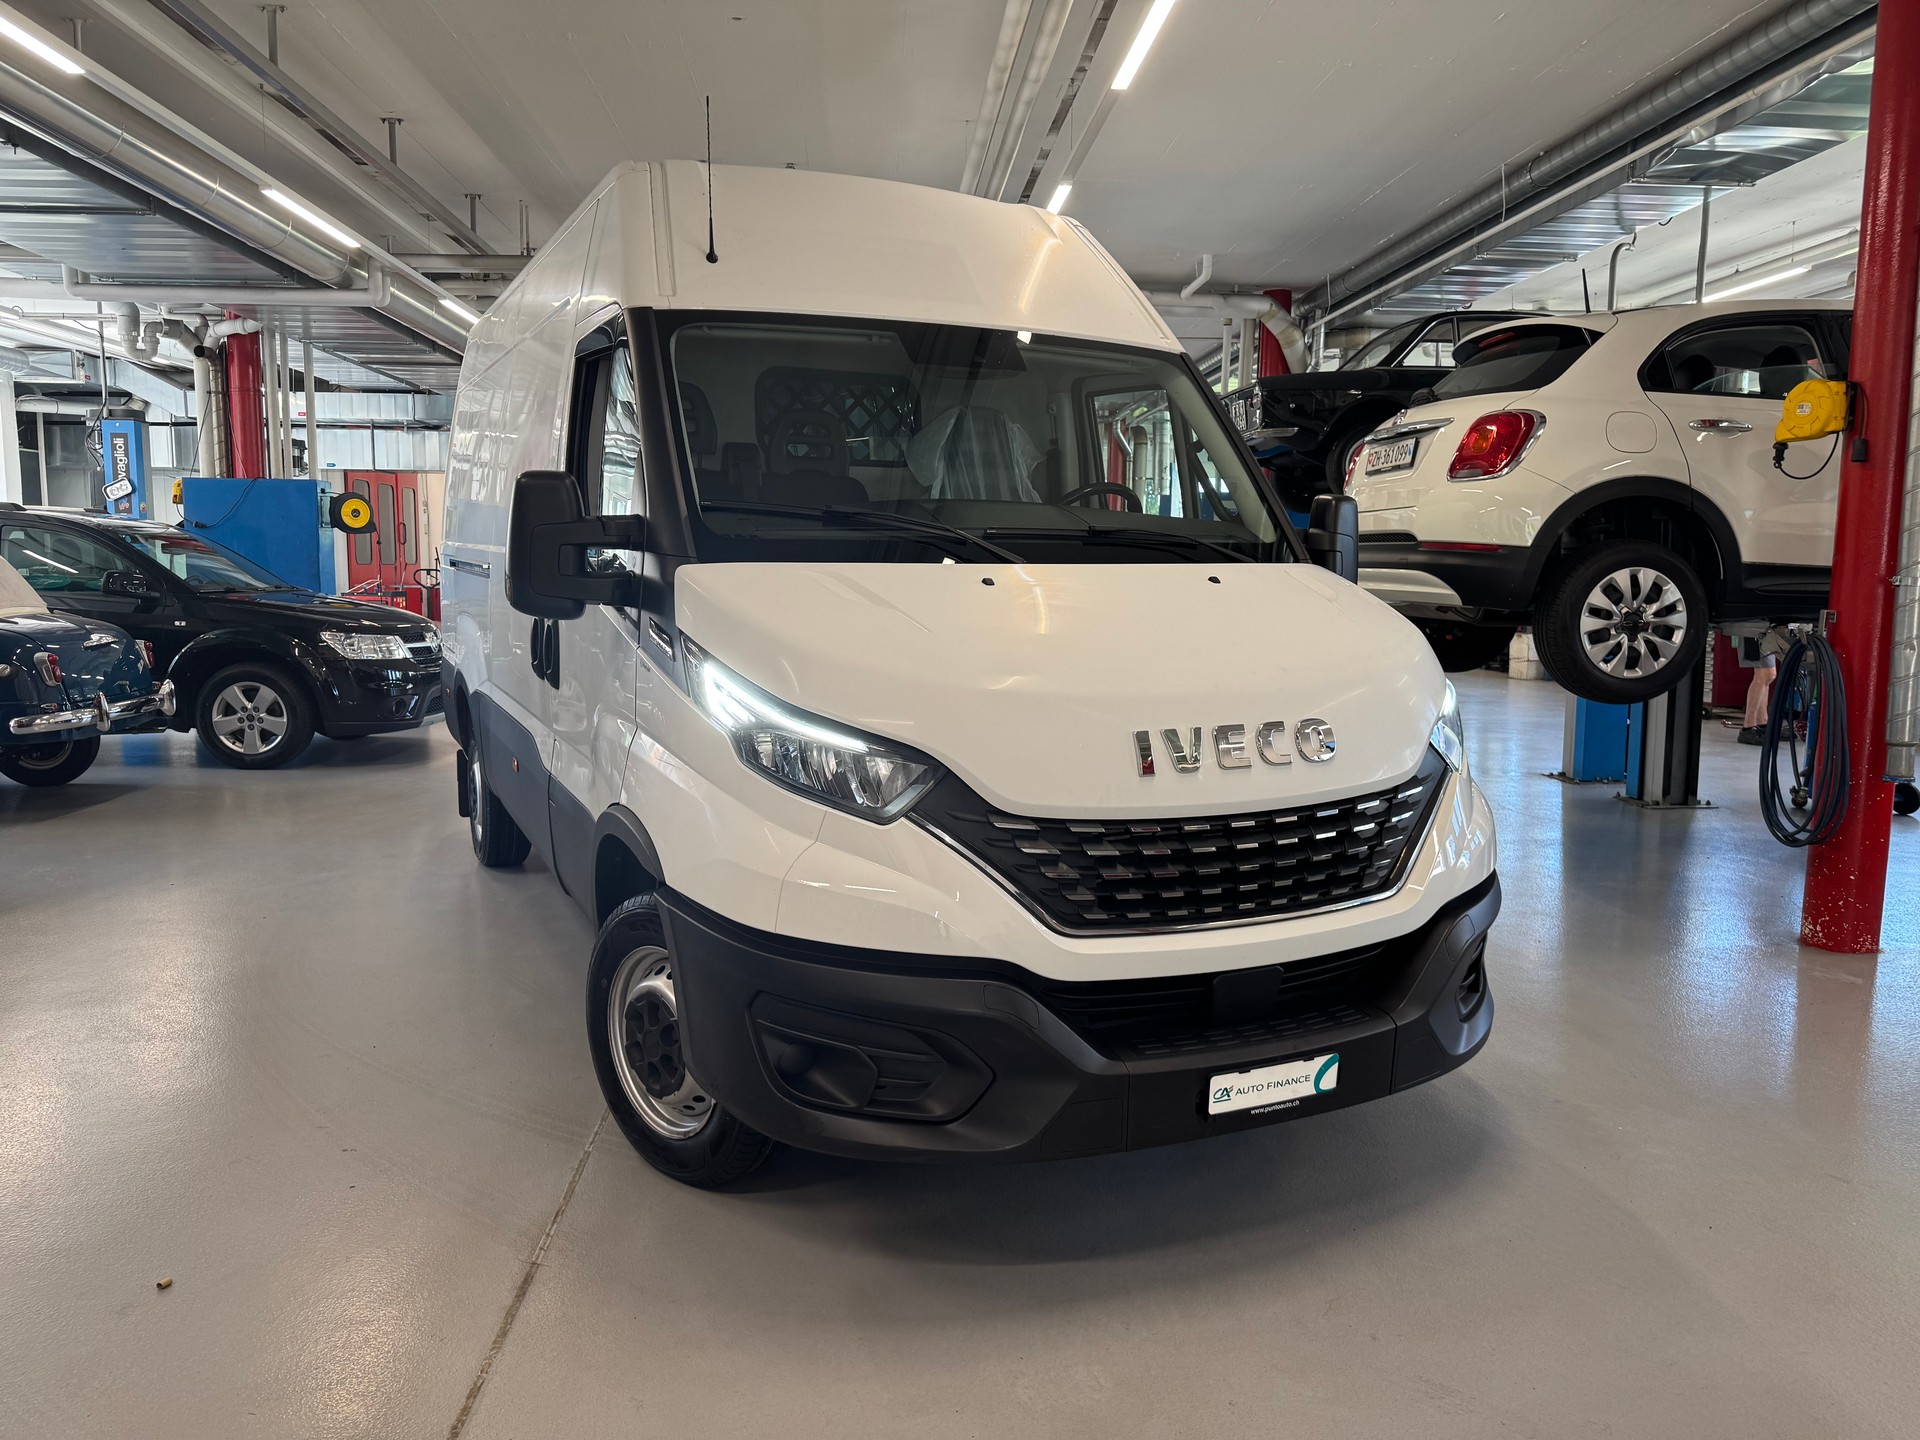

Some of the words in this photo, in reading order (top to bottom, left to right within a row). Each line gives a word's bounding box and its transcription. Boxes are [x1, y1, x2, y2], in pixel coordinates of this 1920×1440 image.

[113, 437, 128, 479] vaglioli
[1132, 718, 1337, 777] IVECO
[1235, 1083, 1264, 1096] AUTO
[1266, 1074, 1311, 1090] FINANCE
